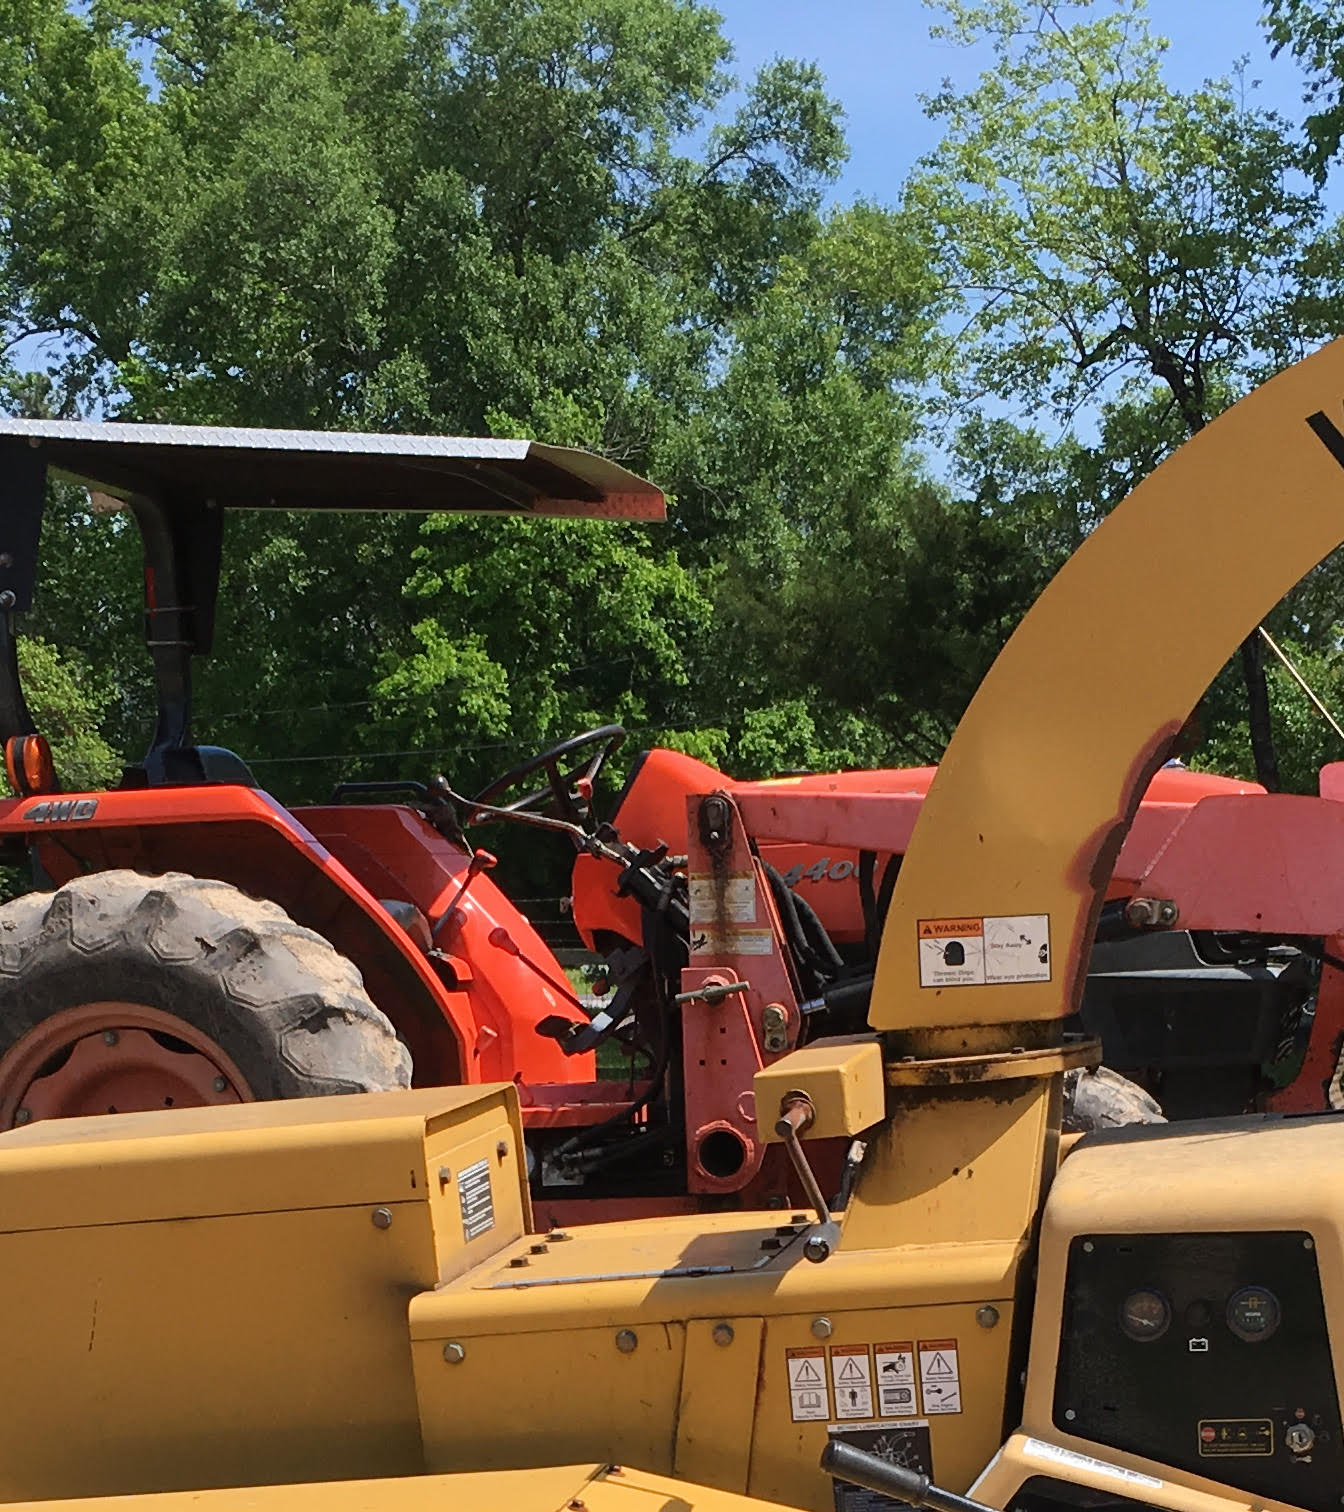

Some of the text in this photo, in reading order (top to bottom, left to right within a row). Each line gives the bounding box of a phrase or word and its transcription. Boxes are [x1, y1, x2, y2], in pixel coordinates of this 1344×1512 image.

[23, 799, 99, 823] 4WD
[783, 857, 879, 888] 440
[934, 922, 981, 933] WARNING
